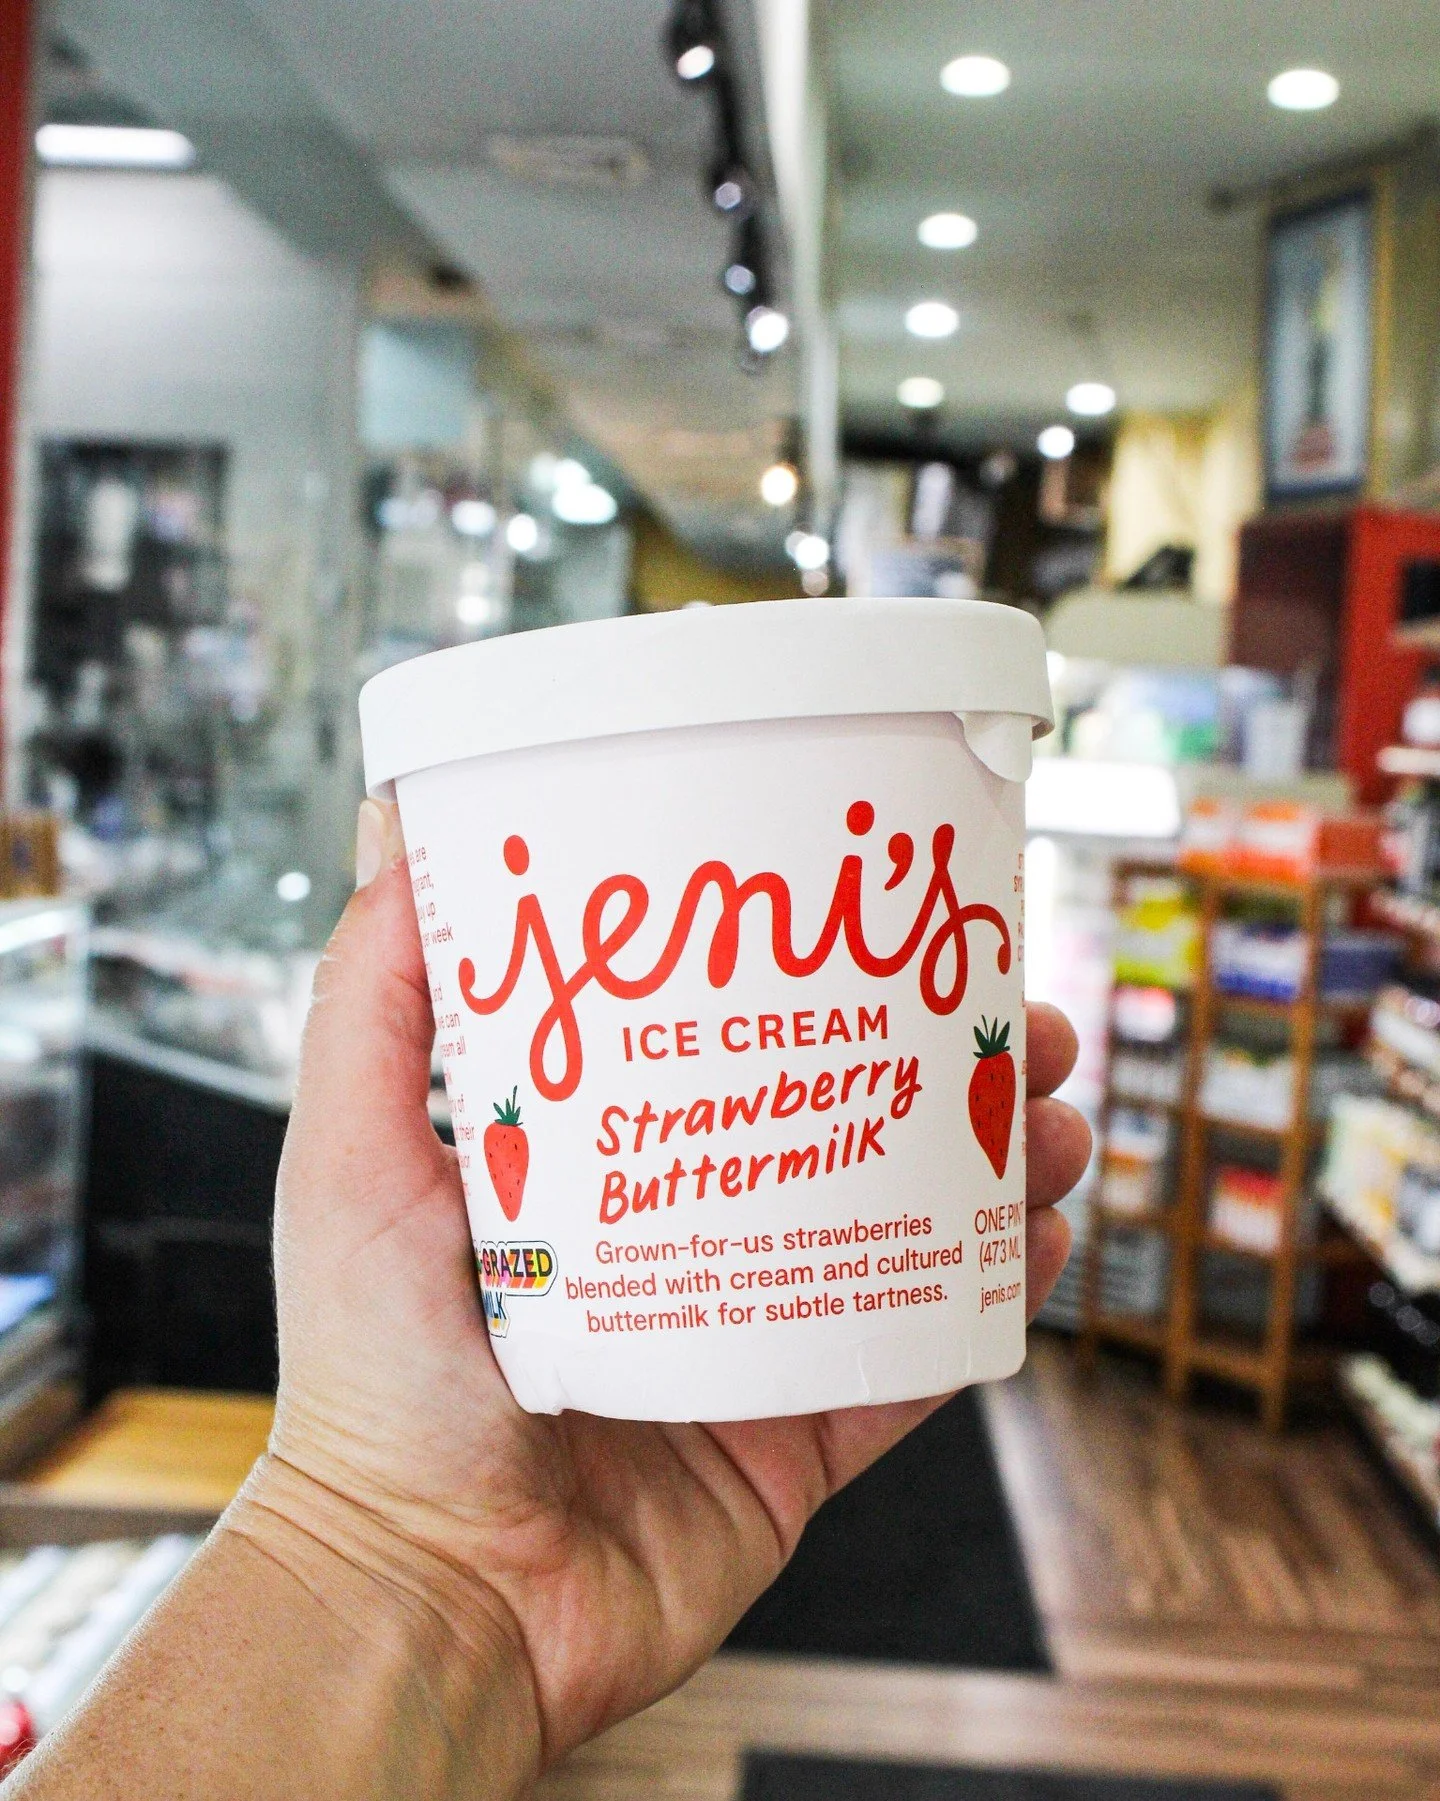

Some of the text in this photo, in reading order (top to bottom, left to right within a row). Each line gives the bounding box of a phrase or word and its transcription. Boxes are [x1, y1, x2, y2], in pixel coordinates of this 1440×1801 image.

[431, 922, 454, 945] week
[458, 800, 1013, 1103] jeni's
[623, 1003, 889, 1063] ICE CREAM
[596, 1056, 922, 1157] Strawberry
[595, 1213, 933, 1265] Grown-for-us strawberries
[974, 1205, 1006, 1236] ONE
[565, 1240, 963, 1300] blended with cream and cultured
[979, 1240, 1007, 1273] (473
[586, 1283, 948, 1333] buttermilk for subtle tartness.
[979, 1282, 1021, 1314] jenis.com
